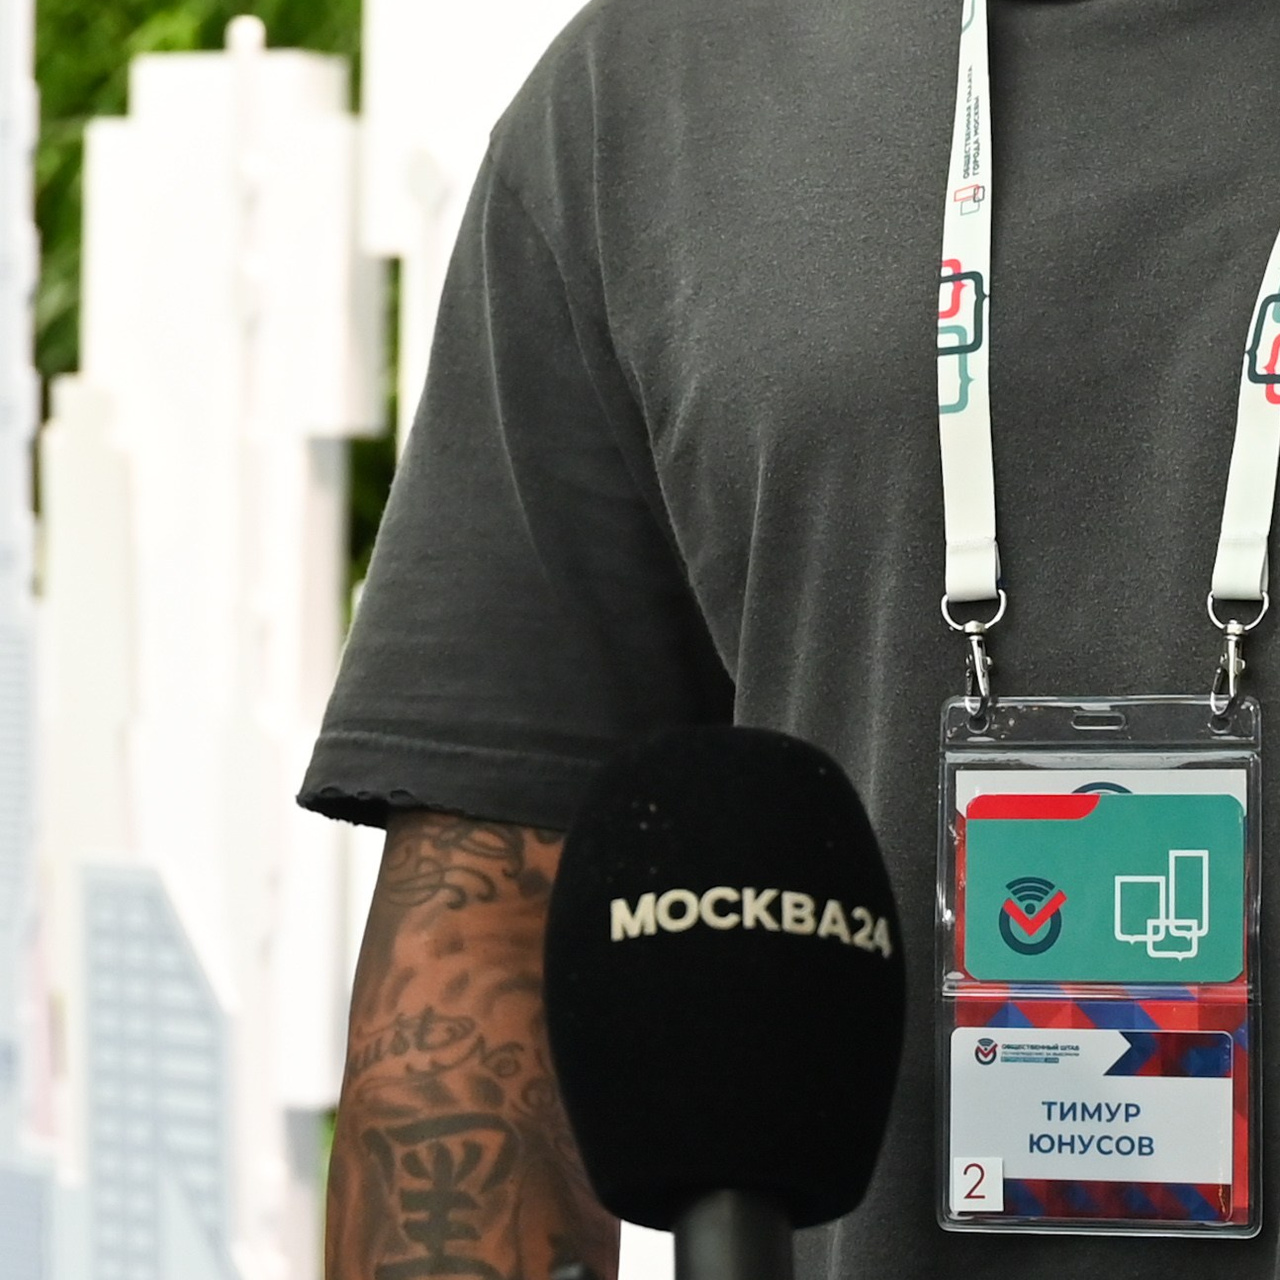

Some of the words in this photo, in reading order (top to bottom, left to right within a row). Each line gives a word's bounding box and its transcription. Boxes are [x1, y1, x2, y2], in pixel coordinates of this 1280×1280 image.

[610, 886, 893, 959] МОСКВА24
[1041, 1101, 1141, 1122] ТИМУР
[1028, 1133, 1155, 1156] ЮНУСОВ
[963, 1163, 986, 1199] 2
